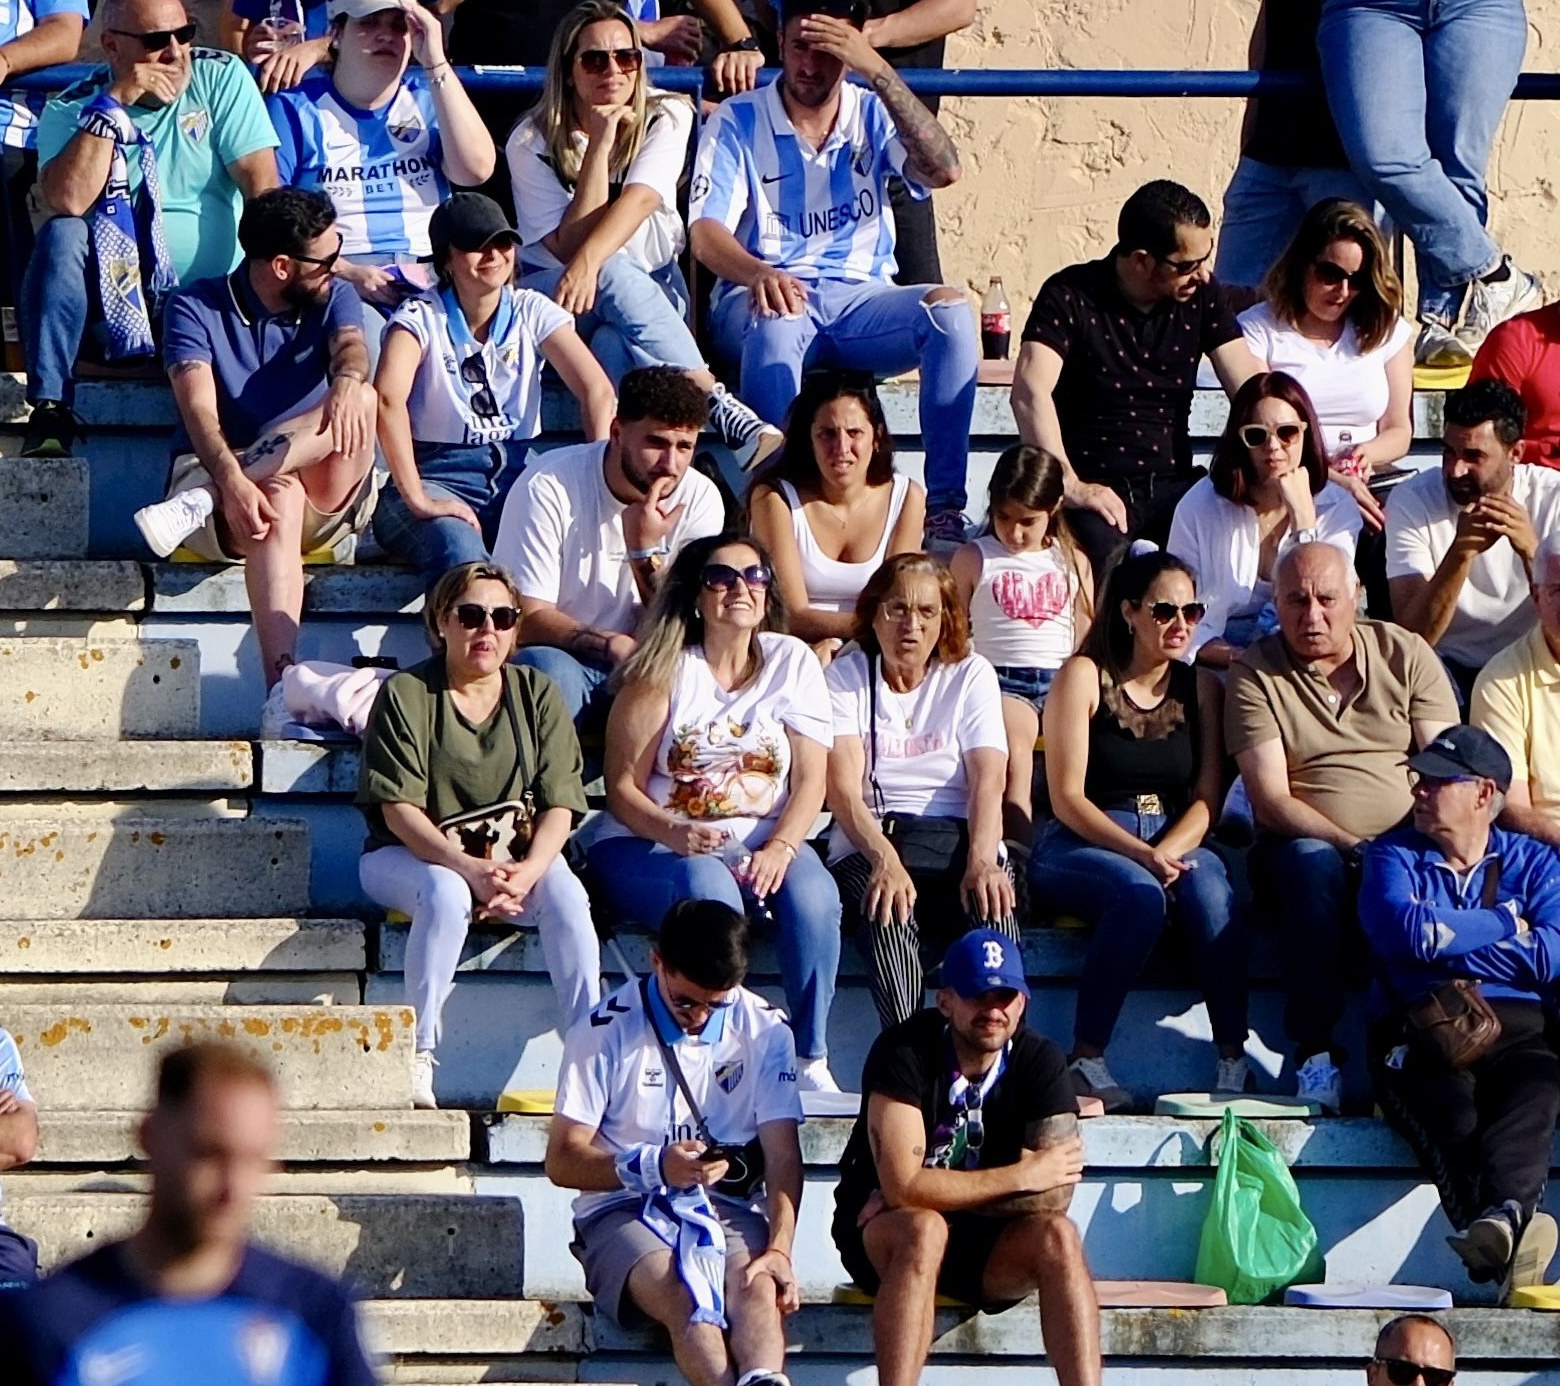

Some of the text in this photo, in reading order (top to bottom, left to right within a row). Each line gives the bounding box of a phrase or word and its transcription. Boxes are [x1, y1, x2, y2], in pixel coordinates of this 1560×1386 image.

[316, 156, 431, 182] MARATHON
[364, 180, 396, 194] BET
[799, 187, 876, 239] UNESCO
[982, 939, 1005, 969] B
